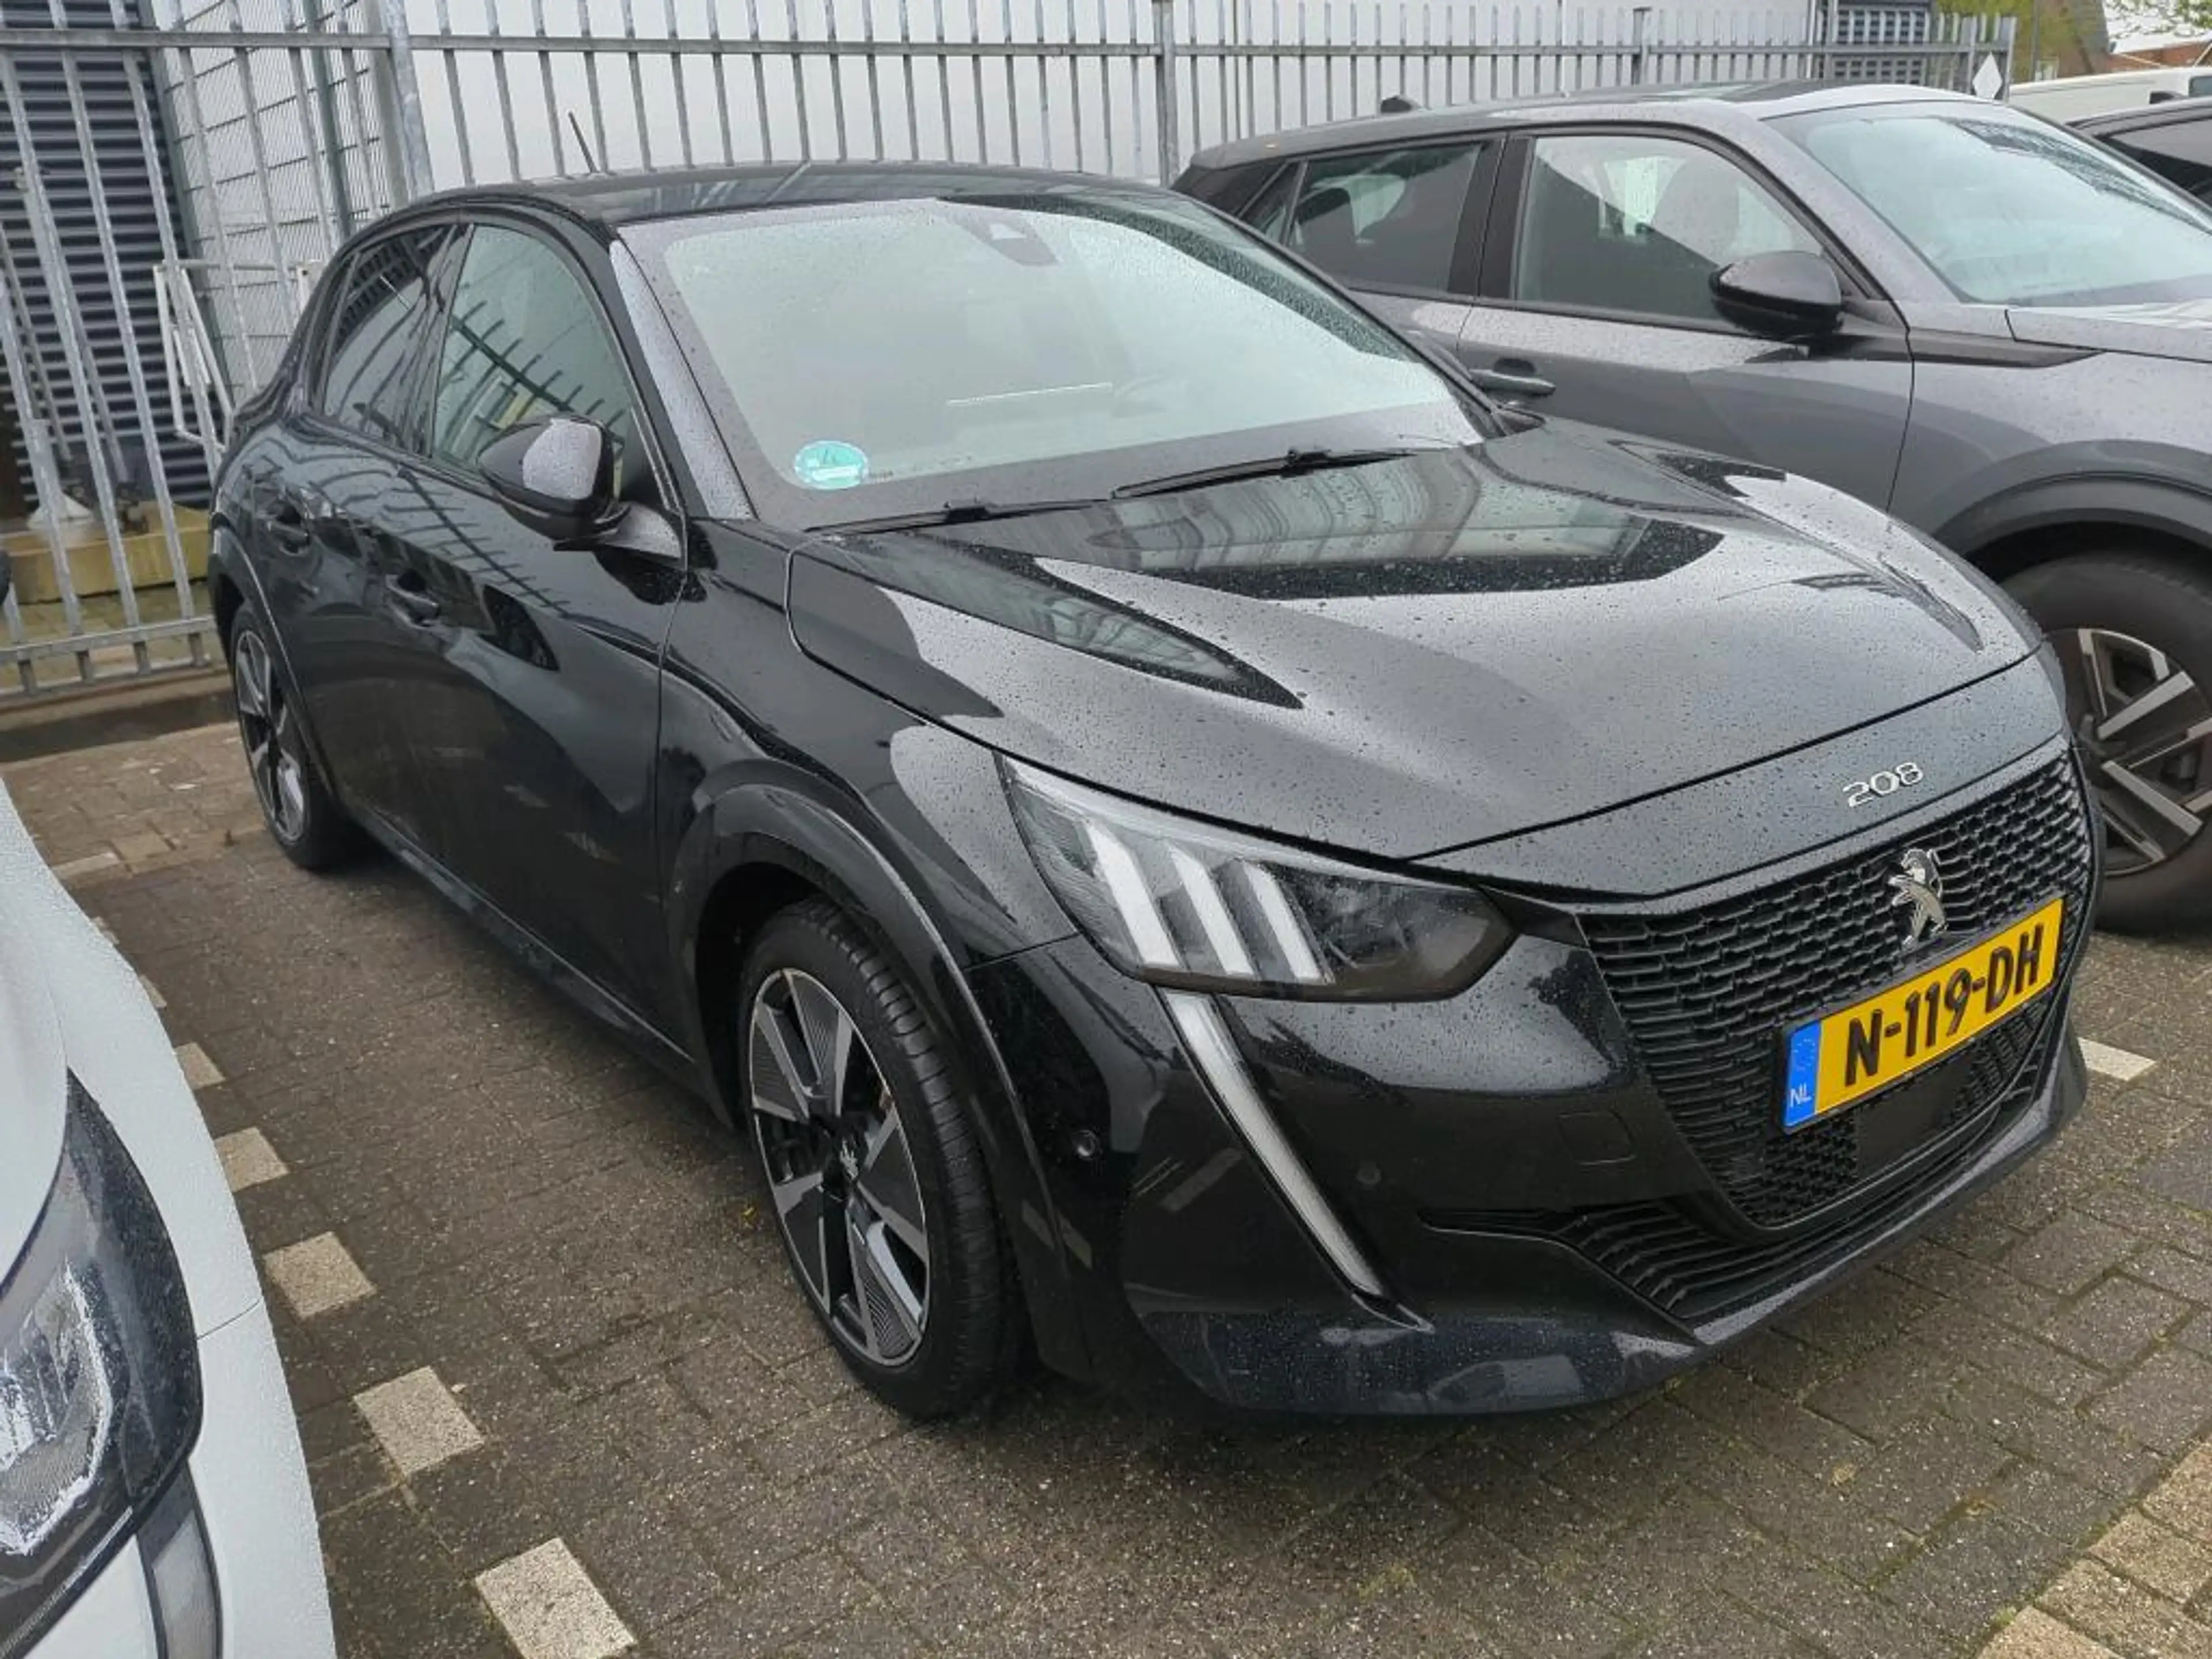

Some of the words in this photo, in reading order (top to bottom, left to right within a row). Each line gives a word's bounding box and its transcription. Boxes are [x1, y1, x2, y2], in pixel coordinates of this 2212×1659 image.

[1843, 762, 1923, 807] 208
[1844, 923, 2044, 1087] N-119-DH
[1790, 1082, 1812, 1108] NL
